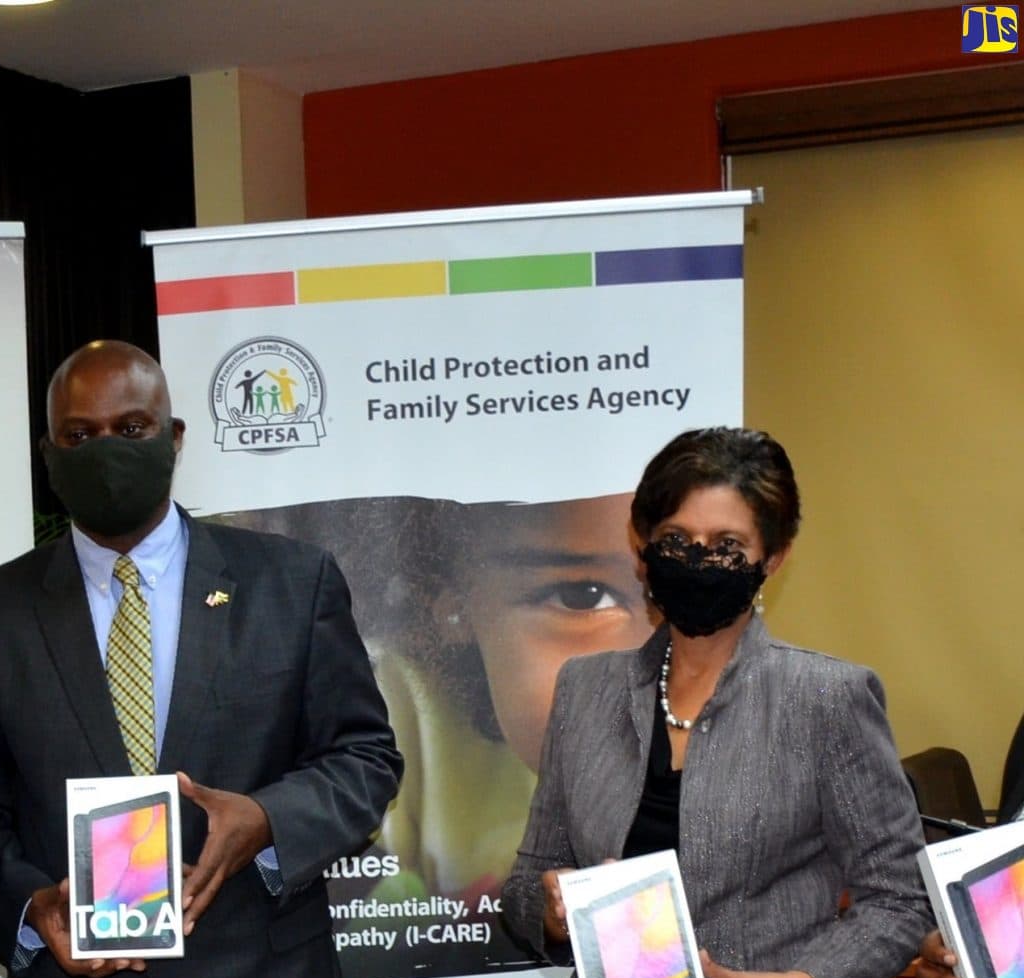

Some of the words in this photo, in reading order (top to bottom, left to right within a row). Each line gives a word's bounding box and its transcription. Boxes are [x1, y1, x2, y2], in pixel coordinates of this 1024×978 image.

[365, 357, 436, 383] Child
[444, 351, 589, 380] Protection
[597, 345, 650, 371] and
[367, 394, 458, 424] Family
[466, 389, 579, 416] Services
[586, 387, 691, 414] Agency
[238, 426, 301, 445] CPFSA
[75, 903, 148, 939] Tab
[152, 902, 177, 936] A
[332, 927, 397, 951] pathy
[406, 922, 492, 947] (I-CARE)
